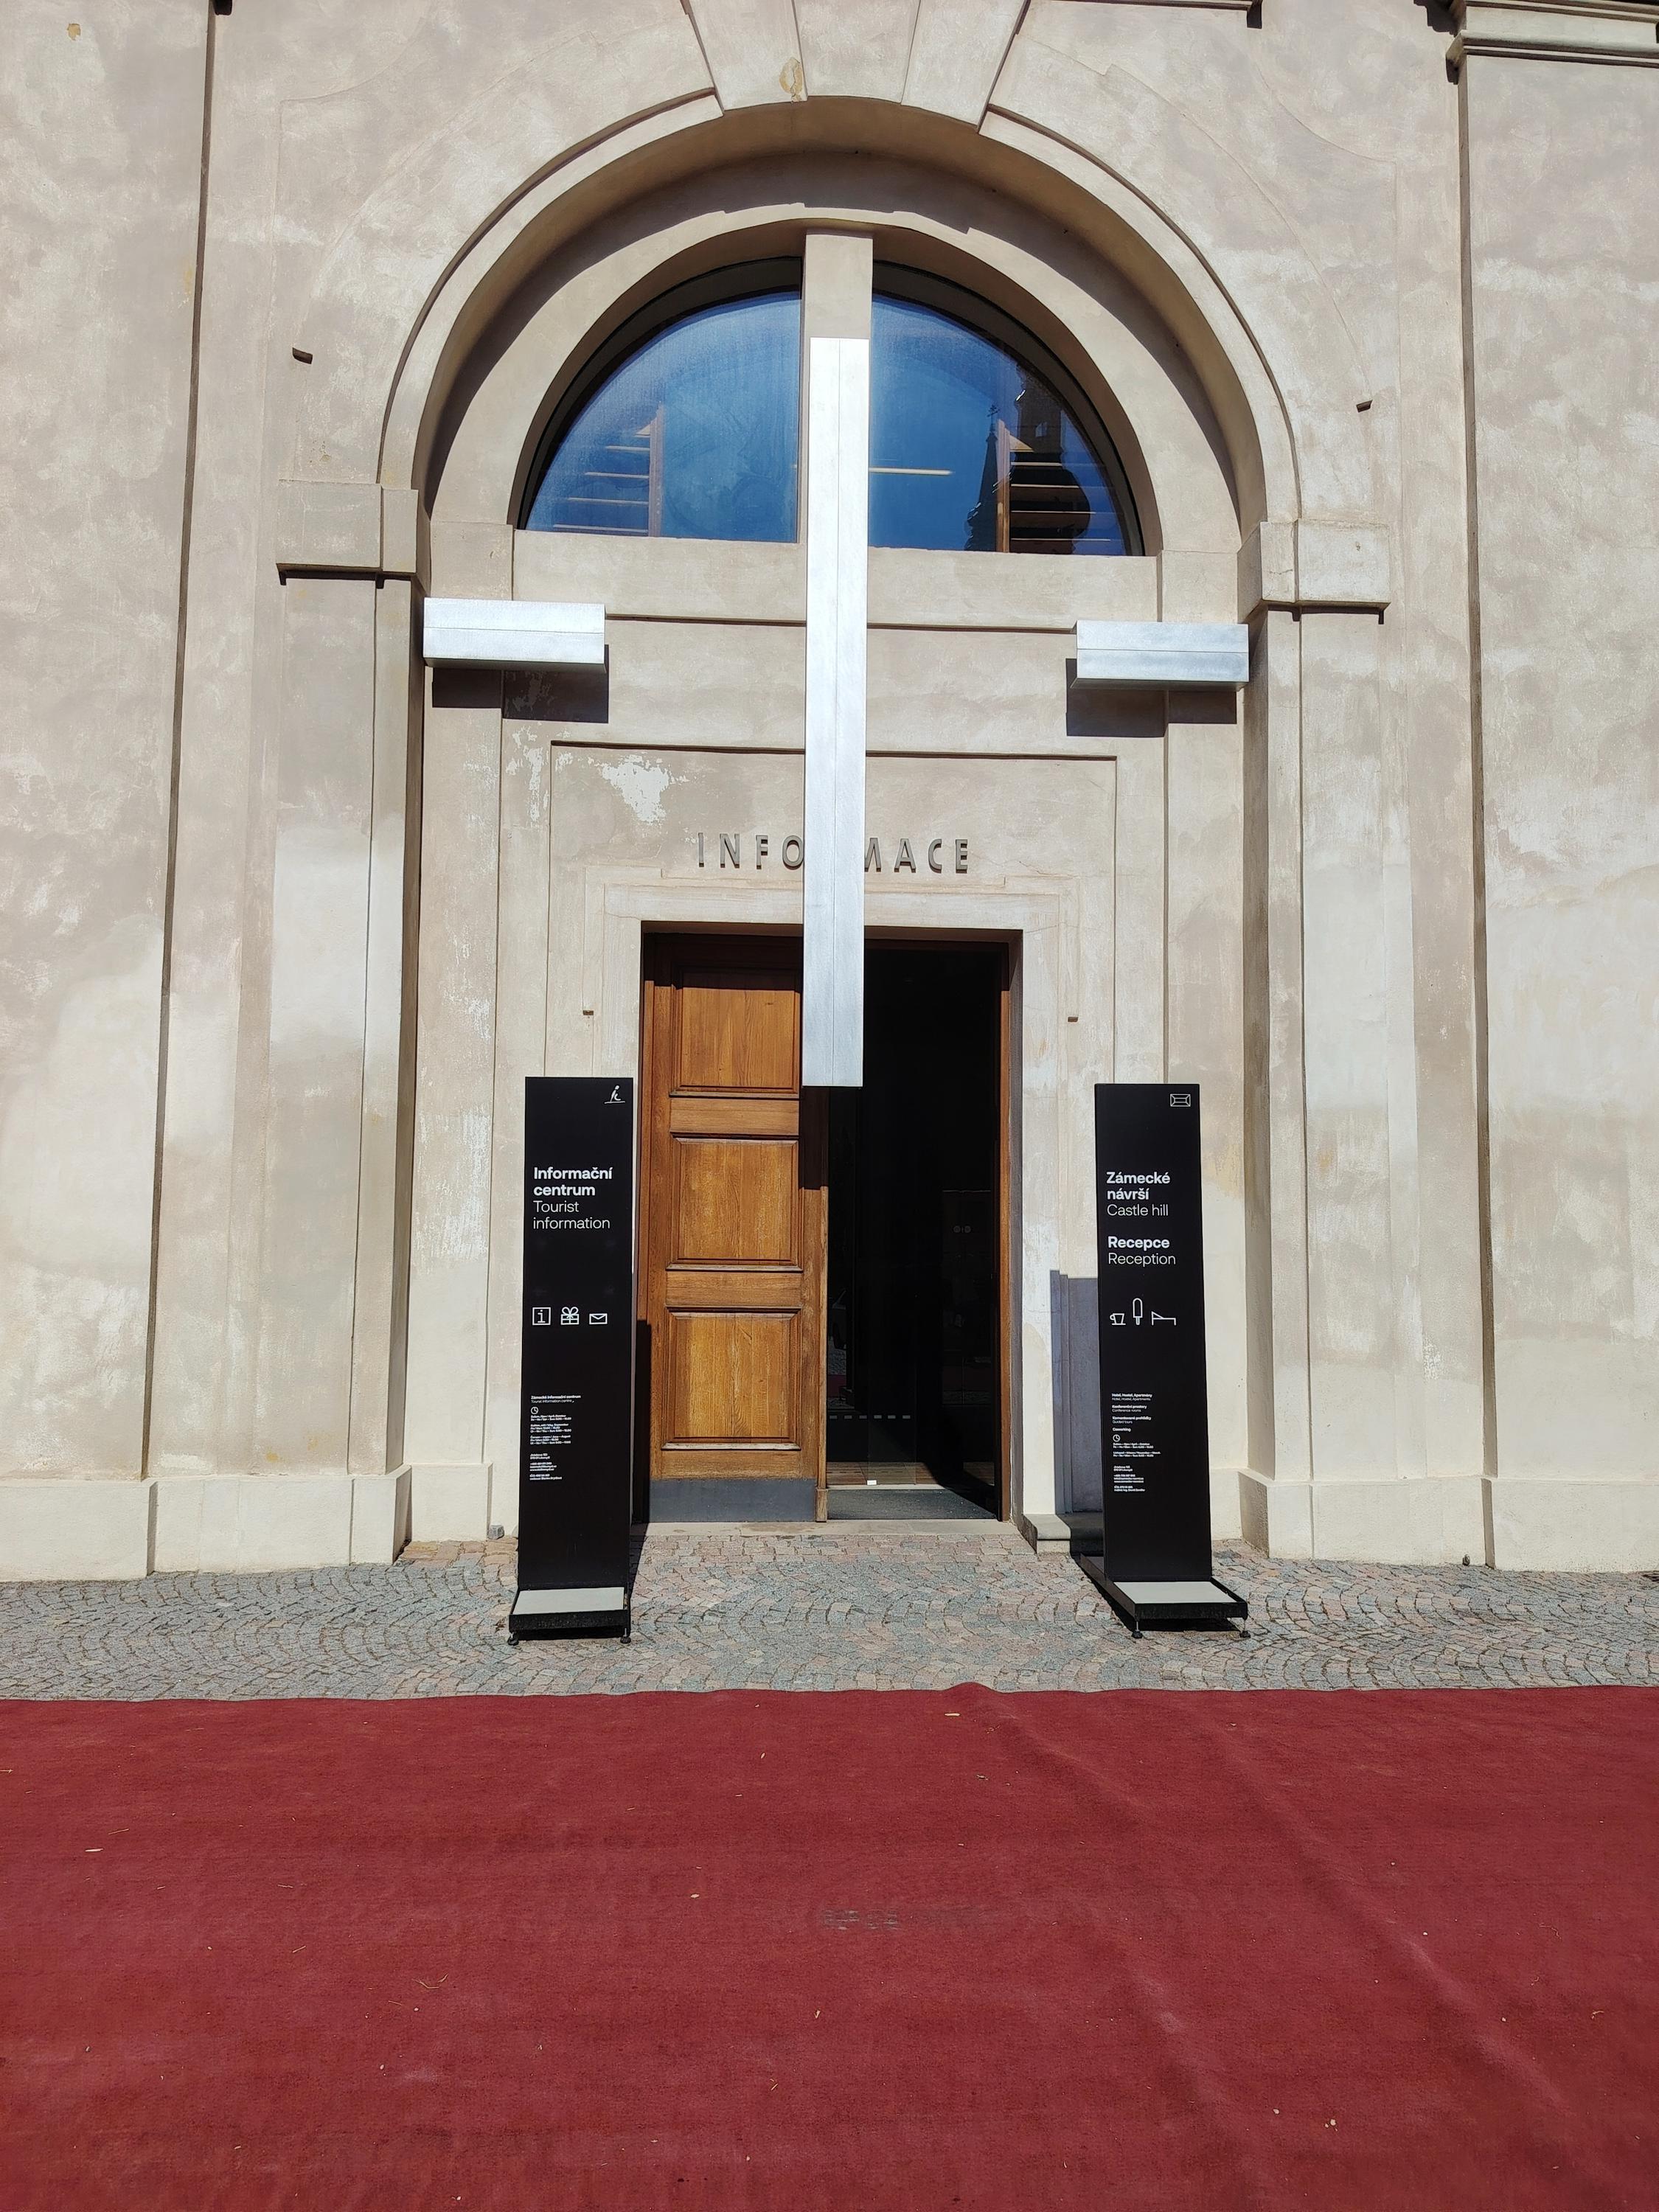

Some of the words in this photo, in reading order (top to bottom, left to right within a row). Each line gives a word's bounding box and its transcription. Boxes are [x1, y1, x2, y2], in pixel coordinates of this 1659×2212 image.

[697, 832, 969, 874] INFOMACE
[534, 1166, 613, 1180] Informační
[1106, 1171, 1171, 1184] Zámecké
[533, 1184, 596, 1196] centrum
[1107, 1187, 1150, 1200] návrší
[532, 1200, 580, 1213] Tourist
[1107, 1204, 1149, 1217] Castle
[1152, 1203, 1169, 1216] hill
[533, 1217, 611, 1229] information
[1107, 1236, 1170, 1251] Recepce
[1108, 1253, 1176, 1267] Reception
